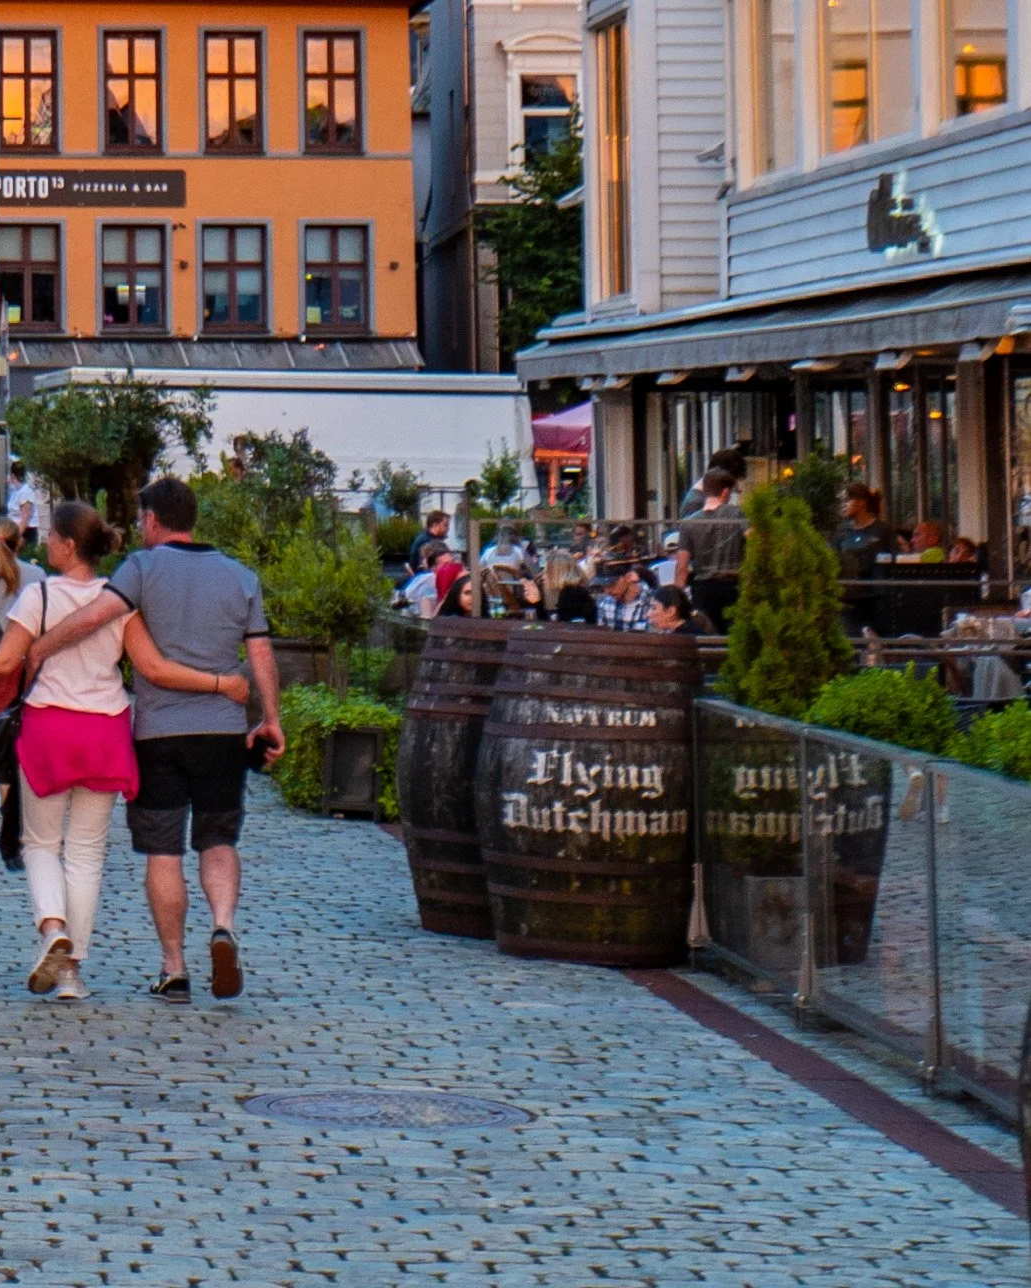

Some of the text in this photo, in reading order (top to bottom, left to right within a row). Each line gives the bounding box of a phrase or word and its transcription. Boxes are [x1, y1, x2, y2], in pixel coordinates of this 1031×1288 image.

[72, 183, 127, 192] PIZZERIA
[145, 183, 169, 192] BAR
[606, 709, 657, 727] RUM
[526, 749, 665, 800] Flying
[500, 792, 687, 842] Dutchman
